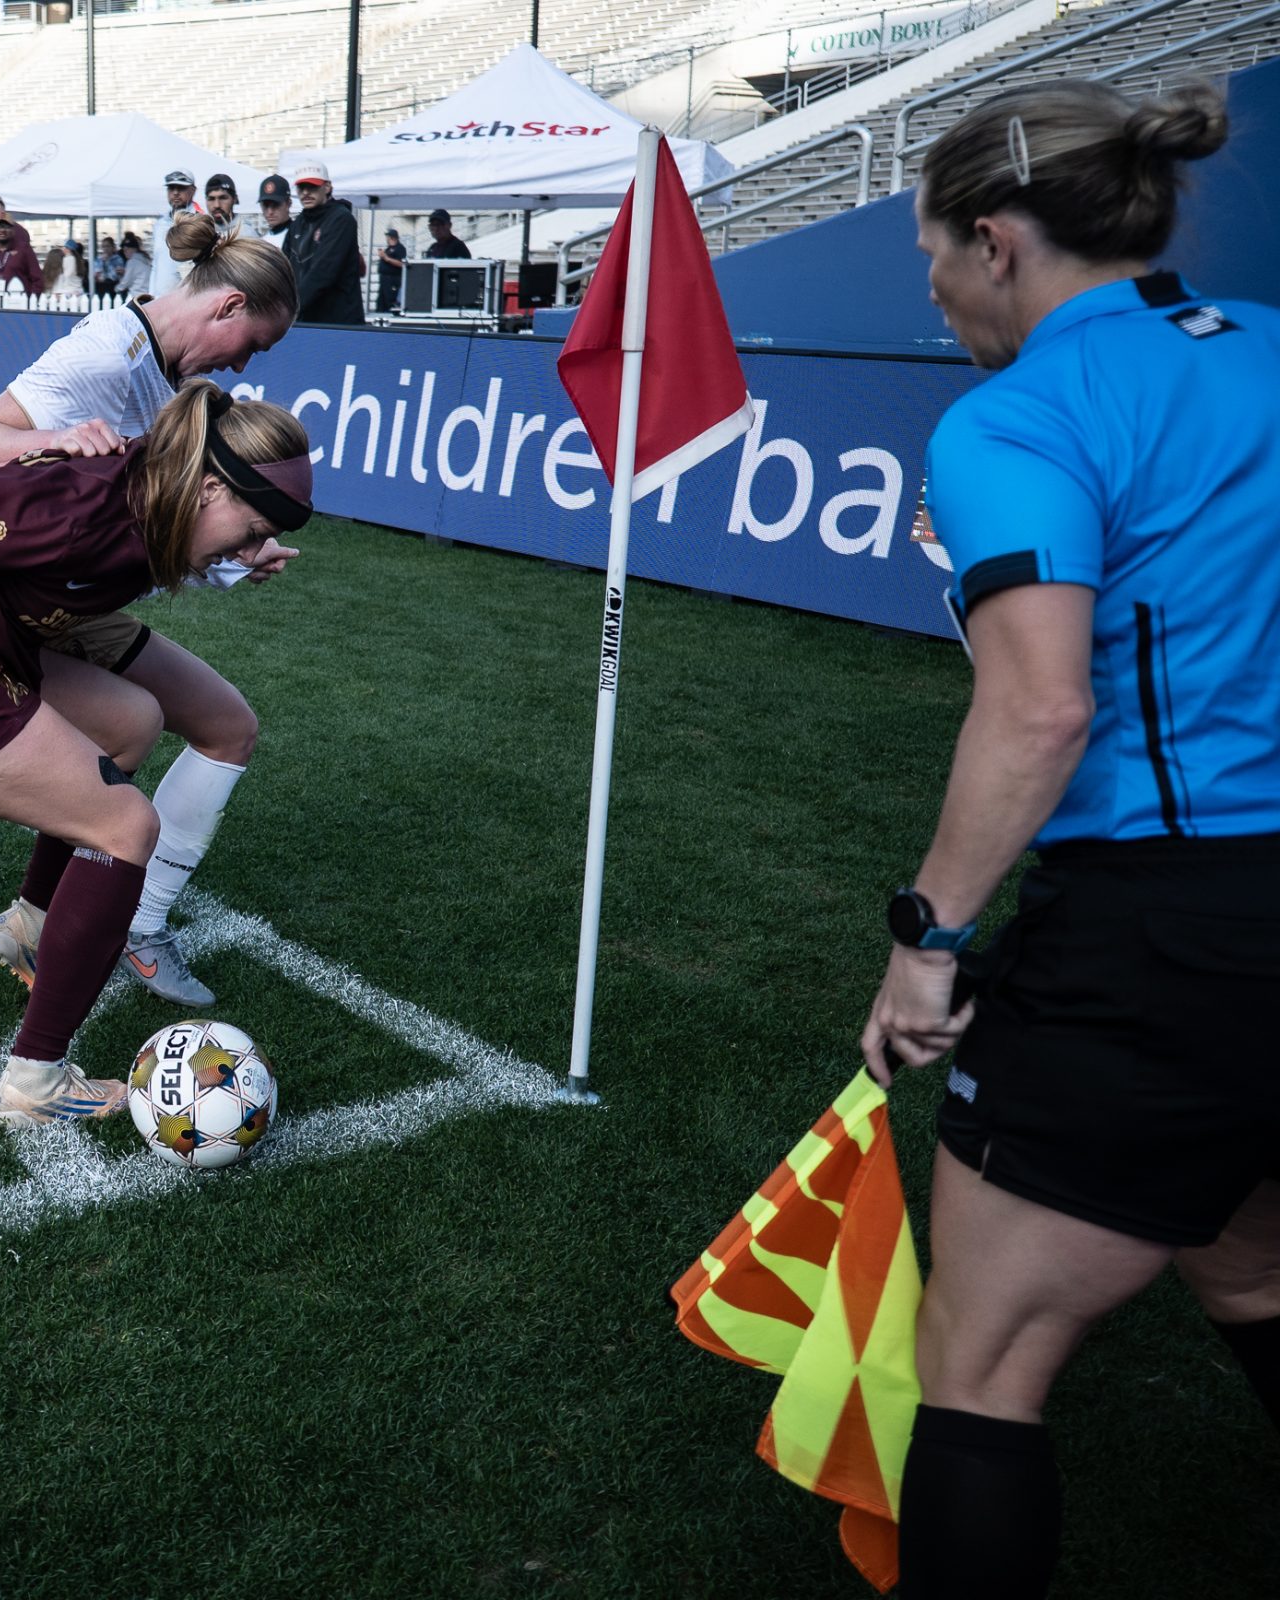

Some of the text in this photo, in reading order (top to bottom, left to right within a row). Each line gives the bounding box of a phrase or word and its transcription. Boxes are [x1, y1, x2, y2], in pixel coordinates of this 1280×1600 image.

[810, 19, 948, 53] COTTON BOWL
[290, 364, 956, 573] childre ba
[160, 1028, 193, 1106] SELECT
